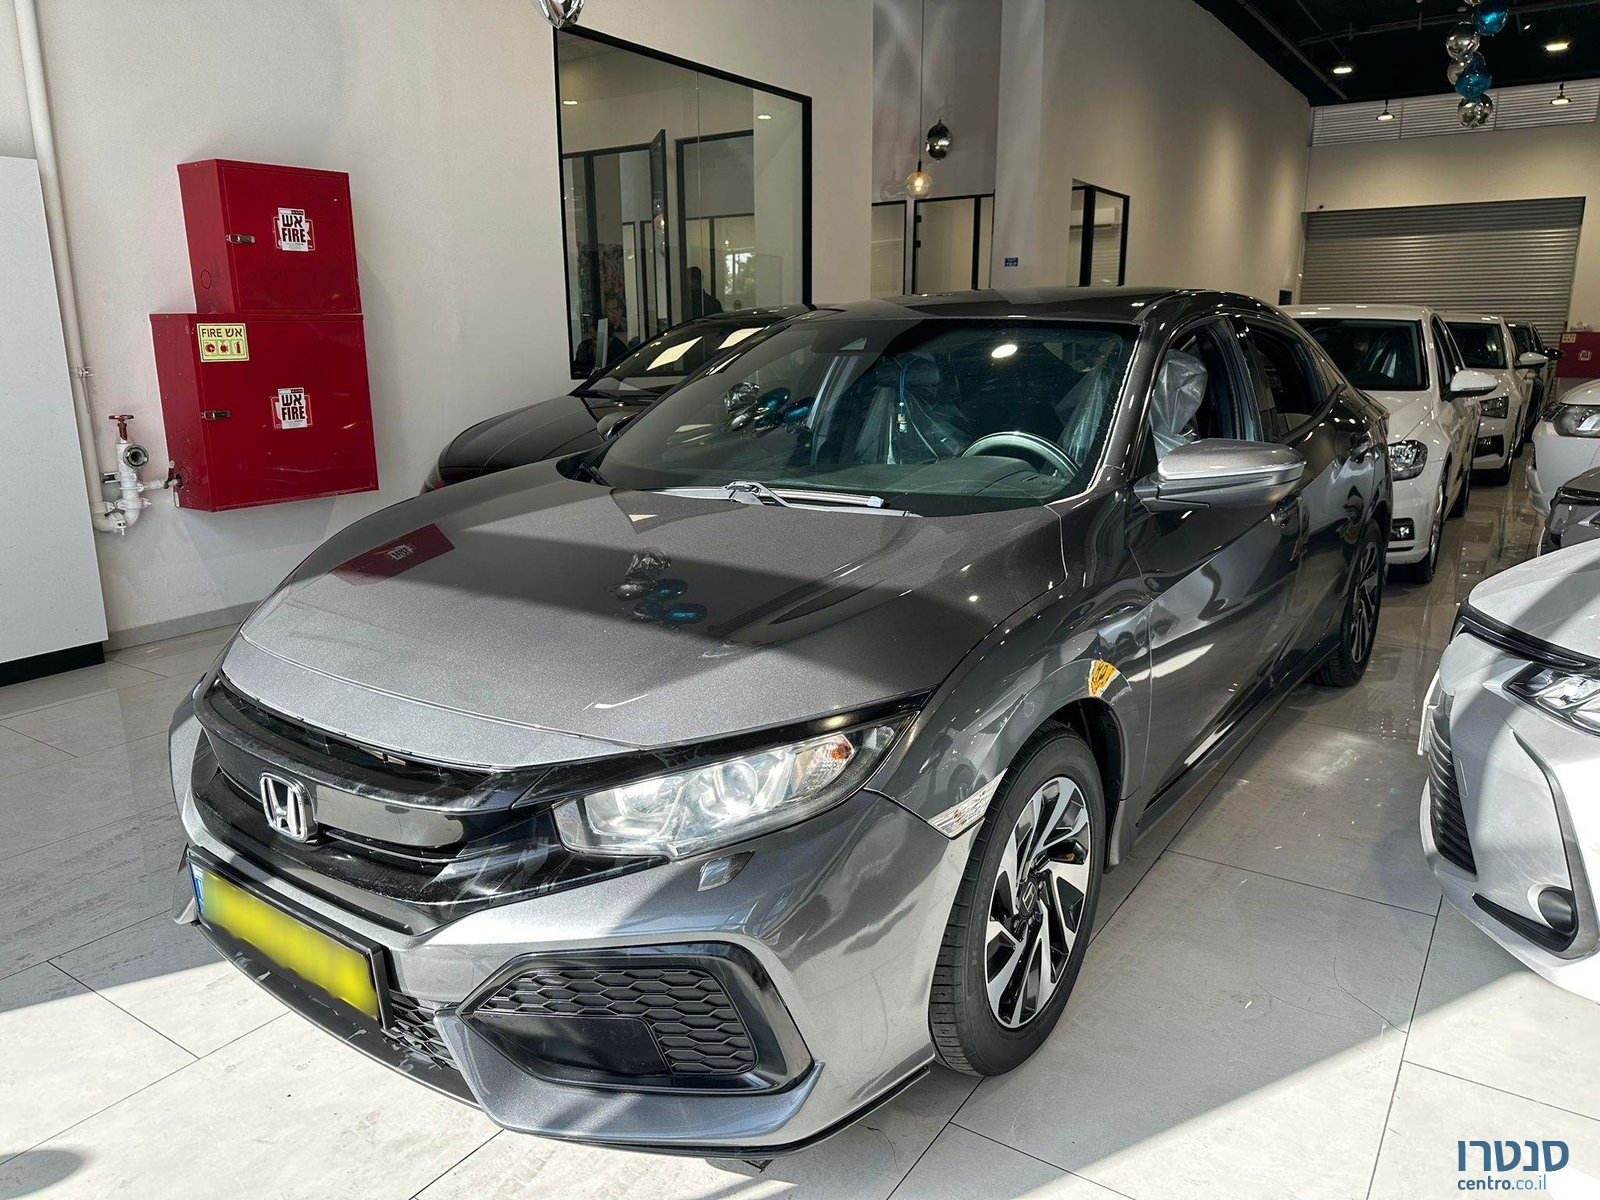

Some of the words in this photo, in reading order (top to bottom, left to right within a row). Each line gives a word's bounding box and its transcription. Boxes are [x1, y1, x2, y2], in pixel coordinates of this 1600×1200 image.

[281, 215, 303, 228] אש
[281, 228, 306, 243] FIRE
[201, 328, 223, 338] FIRE
[225, 328, 243, 338] אש
[281, 394, 302, 406] אש
[281, 406, 306, 421] FIRE
